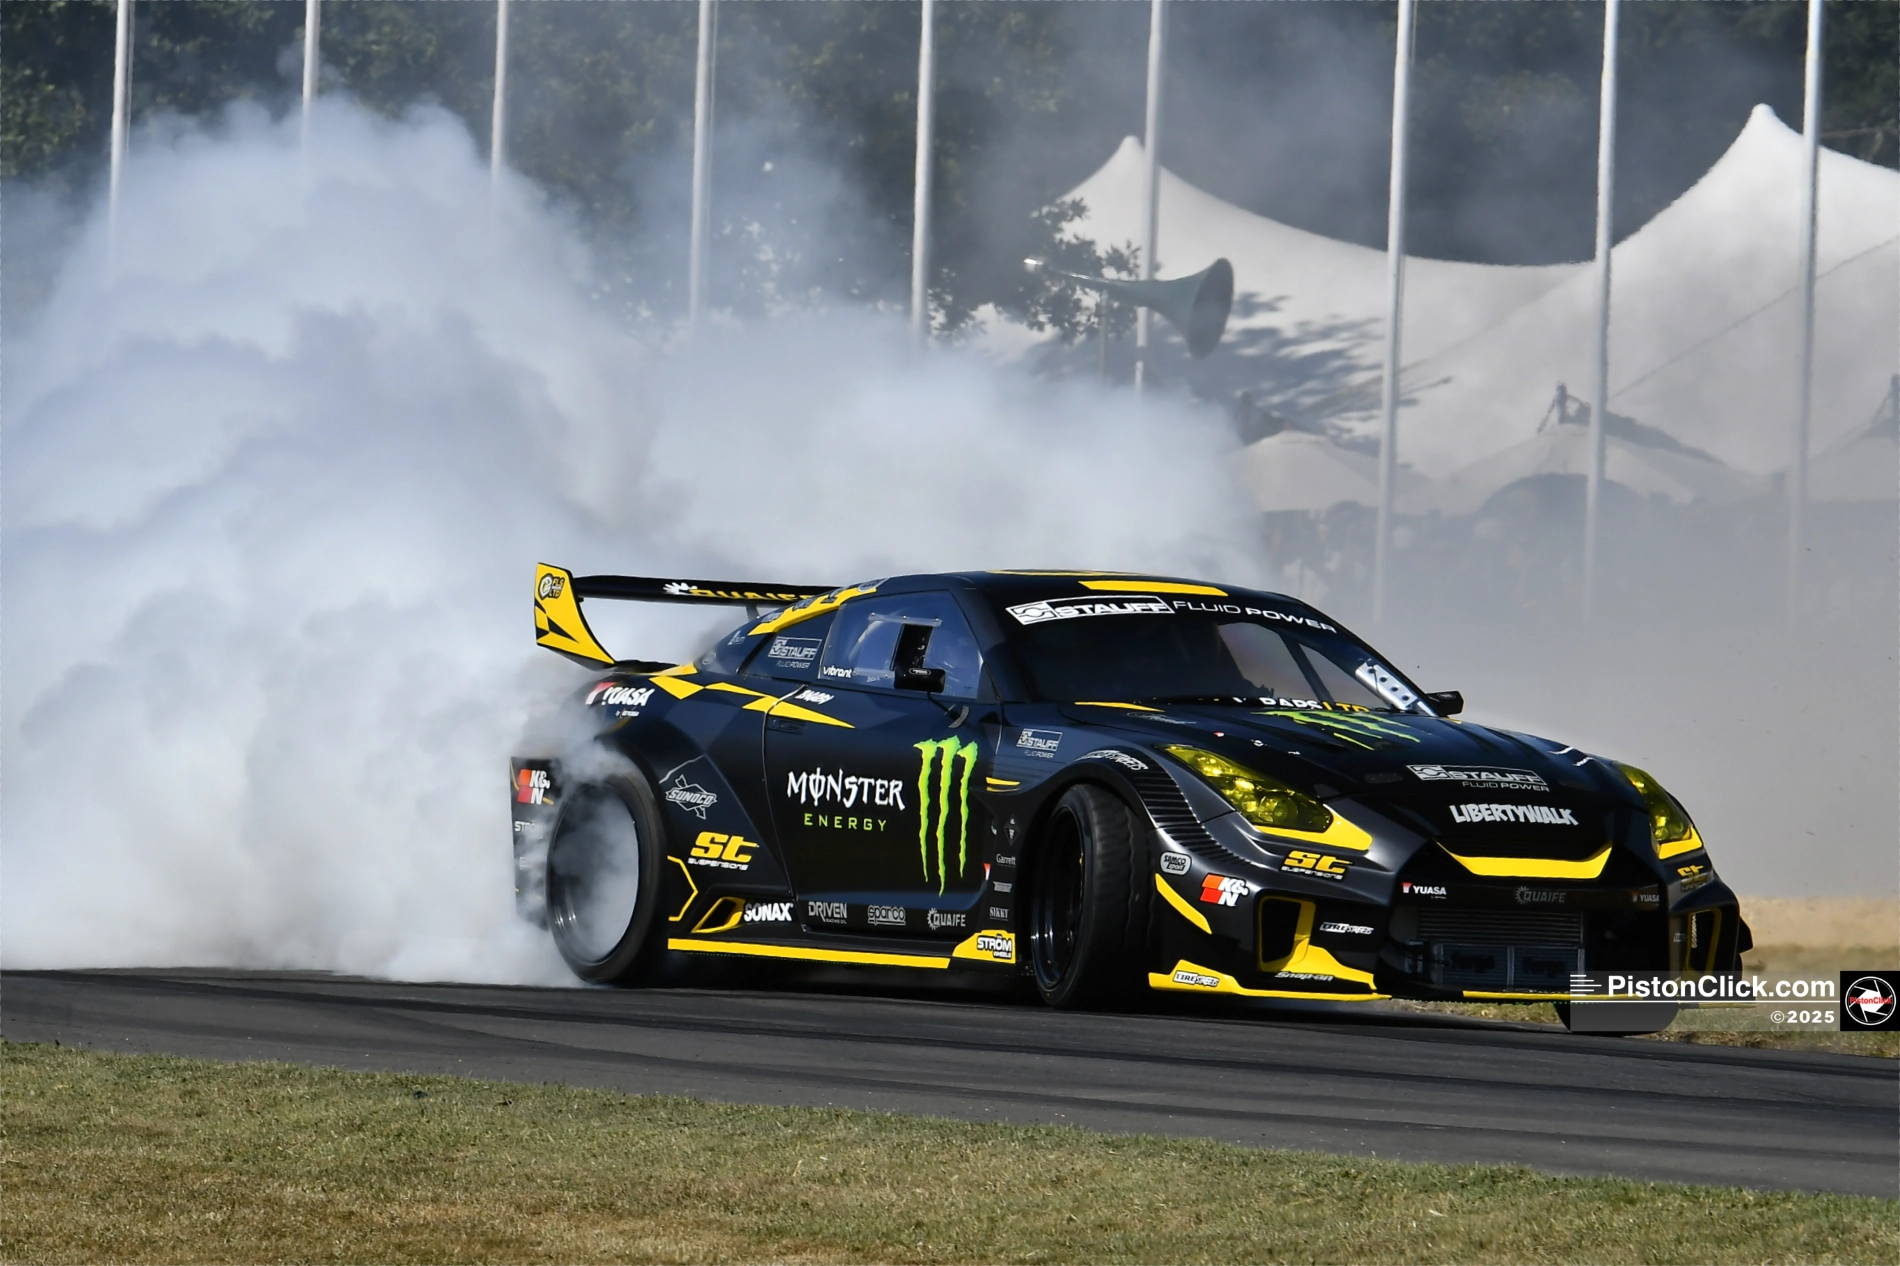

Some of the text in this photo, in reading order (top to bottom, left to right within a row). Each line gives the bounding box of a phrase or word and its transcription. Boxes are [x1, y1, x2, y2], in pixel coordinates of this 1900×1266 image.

[1055, 600, 1337, 634] STAUFF FLUID POWER
[780, 645, 818, 659] STAUFF
[776, 660, 811, 669] FLUID POWER
[823, 665, 852, 679] vibrant
[601, 686, 655, 707] YUASA
[1027, 738, 1059, 750] STAUFF
[1036, 751, 1055, 759] POWER
[1449, 770, 1542, 784] STAUFF
[529, 770, 551, 805] K&N
[786, 767, 906, 811] MONSTER
[1500, 782, 1550, 792] POWER
[668, 789, 716, 805] SUNOCO
[1449, 803, 1579, 826] LIBERTYWALK
[804, 813, 887, 832] ENERGY
[996, 854, 1017, 865] Garrett
[1164, 854, 1187, 866] SAMCO
[1217, 876, 1249, 907] K&N
[1412, 885, 1447, 895] YUASA
[1521, 889, 1567, 903] QUAIFE
[743, 902, 792, 922] SONAX
[808, 901, 847, 921] DRIVEN
[989, 906, 1010, 919] SIKKY
[933, 912, 966, 927] QUAIFE
[977, 934, 1012, 951] STRÖM
[1275, 971, 1335, 982] Snap-on
